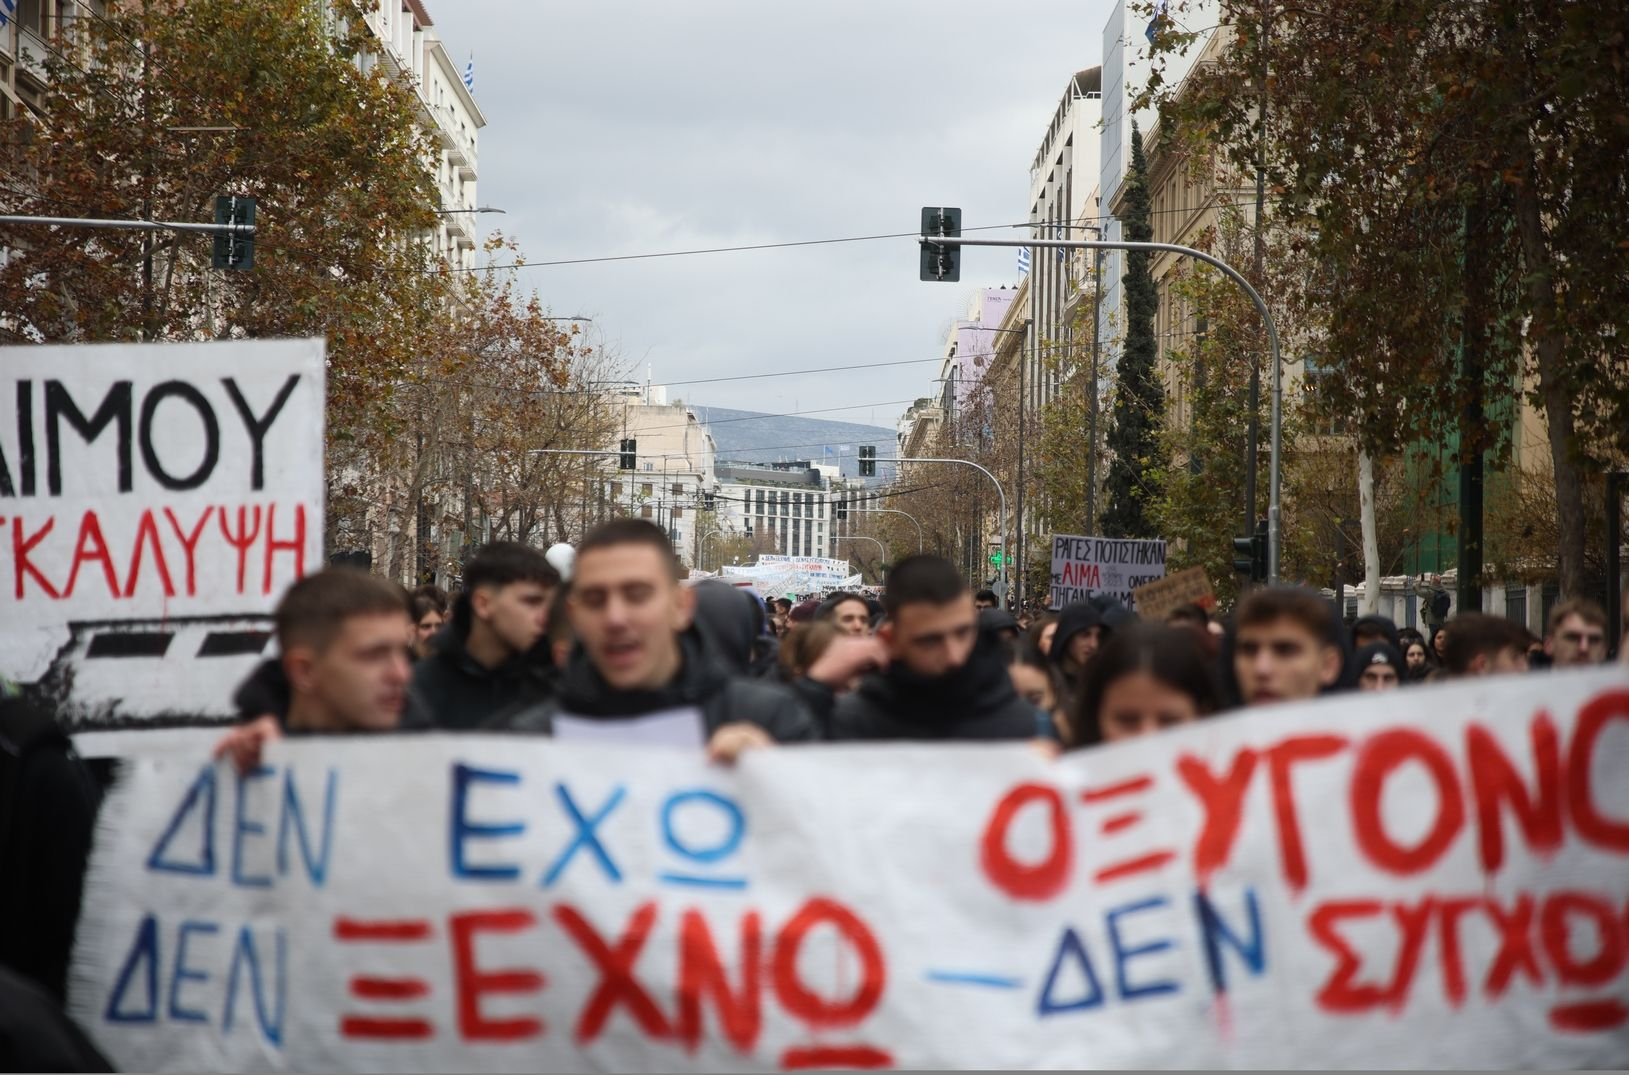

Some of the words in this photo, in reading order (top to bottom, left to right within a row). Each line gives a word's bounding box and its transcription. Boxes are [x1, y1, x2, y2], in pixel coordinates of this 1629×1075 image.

[0, 374, 301, 498] ΙΜΟΥ
[0, 502, 306, 600] ΚΑΛΥΨΗ
[1055, 538, 1091, 562] ΡΑΓΕΣ
[1095, 541, 1165, 564] ΠΟΤΙΣΤΗΚΑΝ
[1062, 562, 1100, 588] ΑΙΜΑ
[146, 764, 339, 888] ΔΕΝ
[105, 912, 287, 1049] ΔΕΝ
[1037, 887, 1269, 1019] ΔΕΝ
